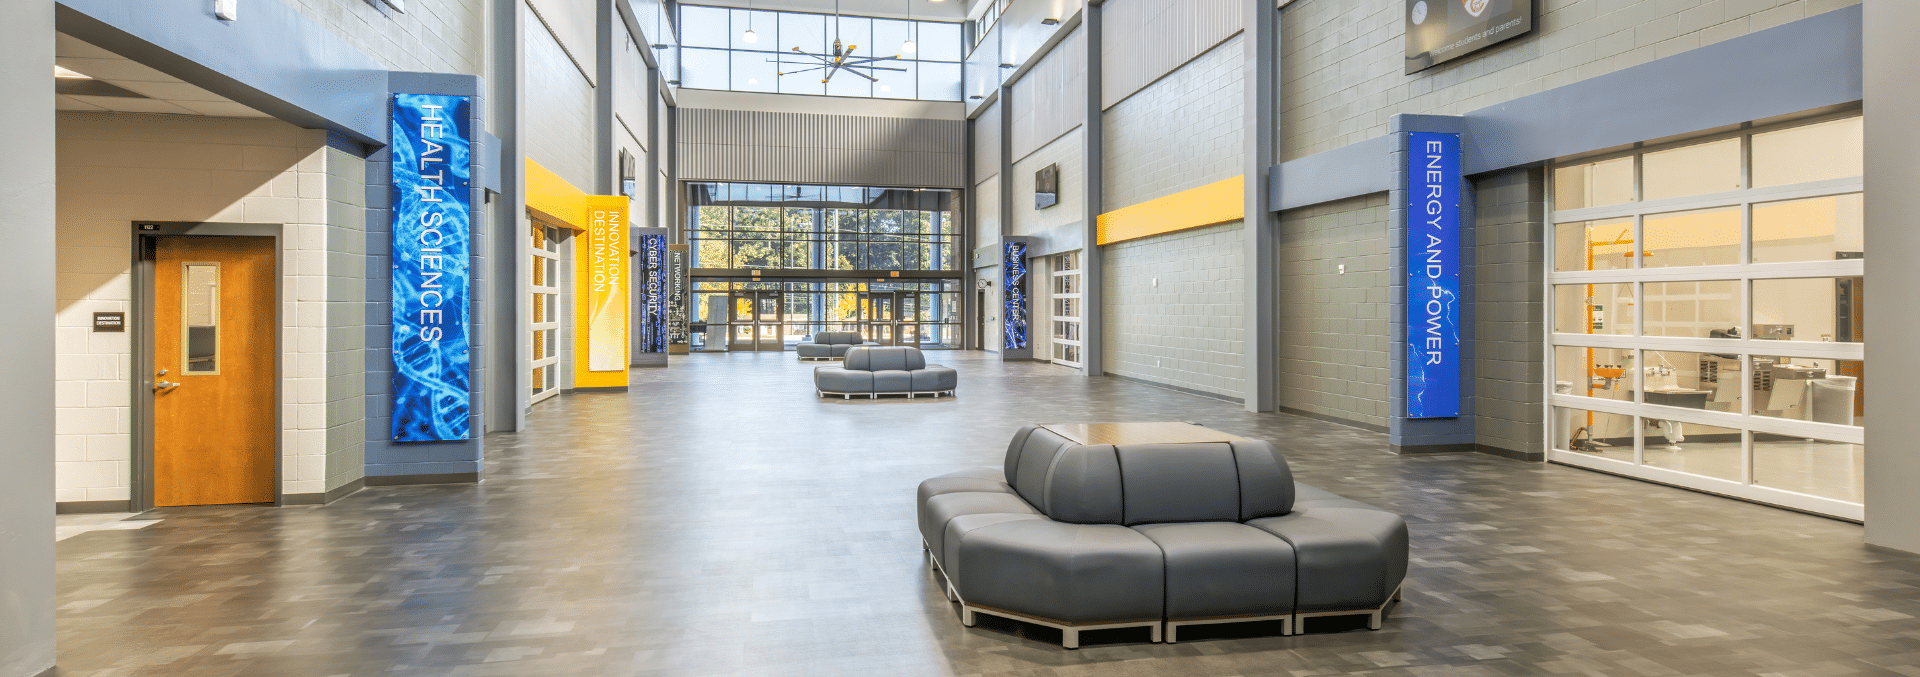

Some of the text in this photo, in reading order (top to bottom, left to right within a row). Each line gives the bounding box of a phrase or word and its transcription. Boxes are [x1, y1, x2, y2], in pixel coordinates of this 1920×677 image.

[1455, 33, 1482, 47] students
[1482, 26, 1495, 38] and
[1495, 16, 1522, 34] parents!
[420, 104, 443, 342] HEALTH SCIENCES
[594, 210, 605, 292] DESTINATION
[608, 211, 620, 285] INNOVATION
[1426, 140, 1442, 366] ENERGY AND POWER
[649, 238, 658, 316] CYBER SECURITY
[1012, 245, 1020, 321] BUSINESS CENTER
